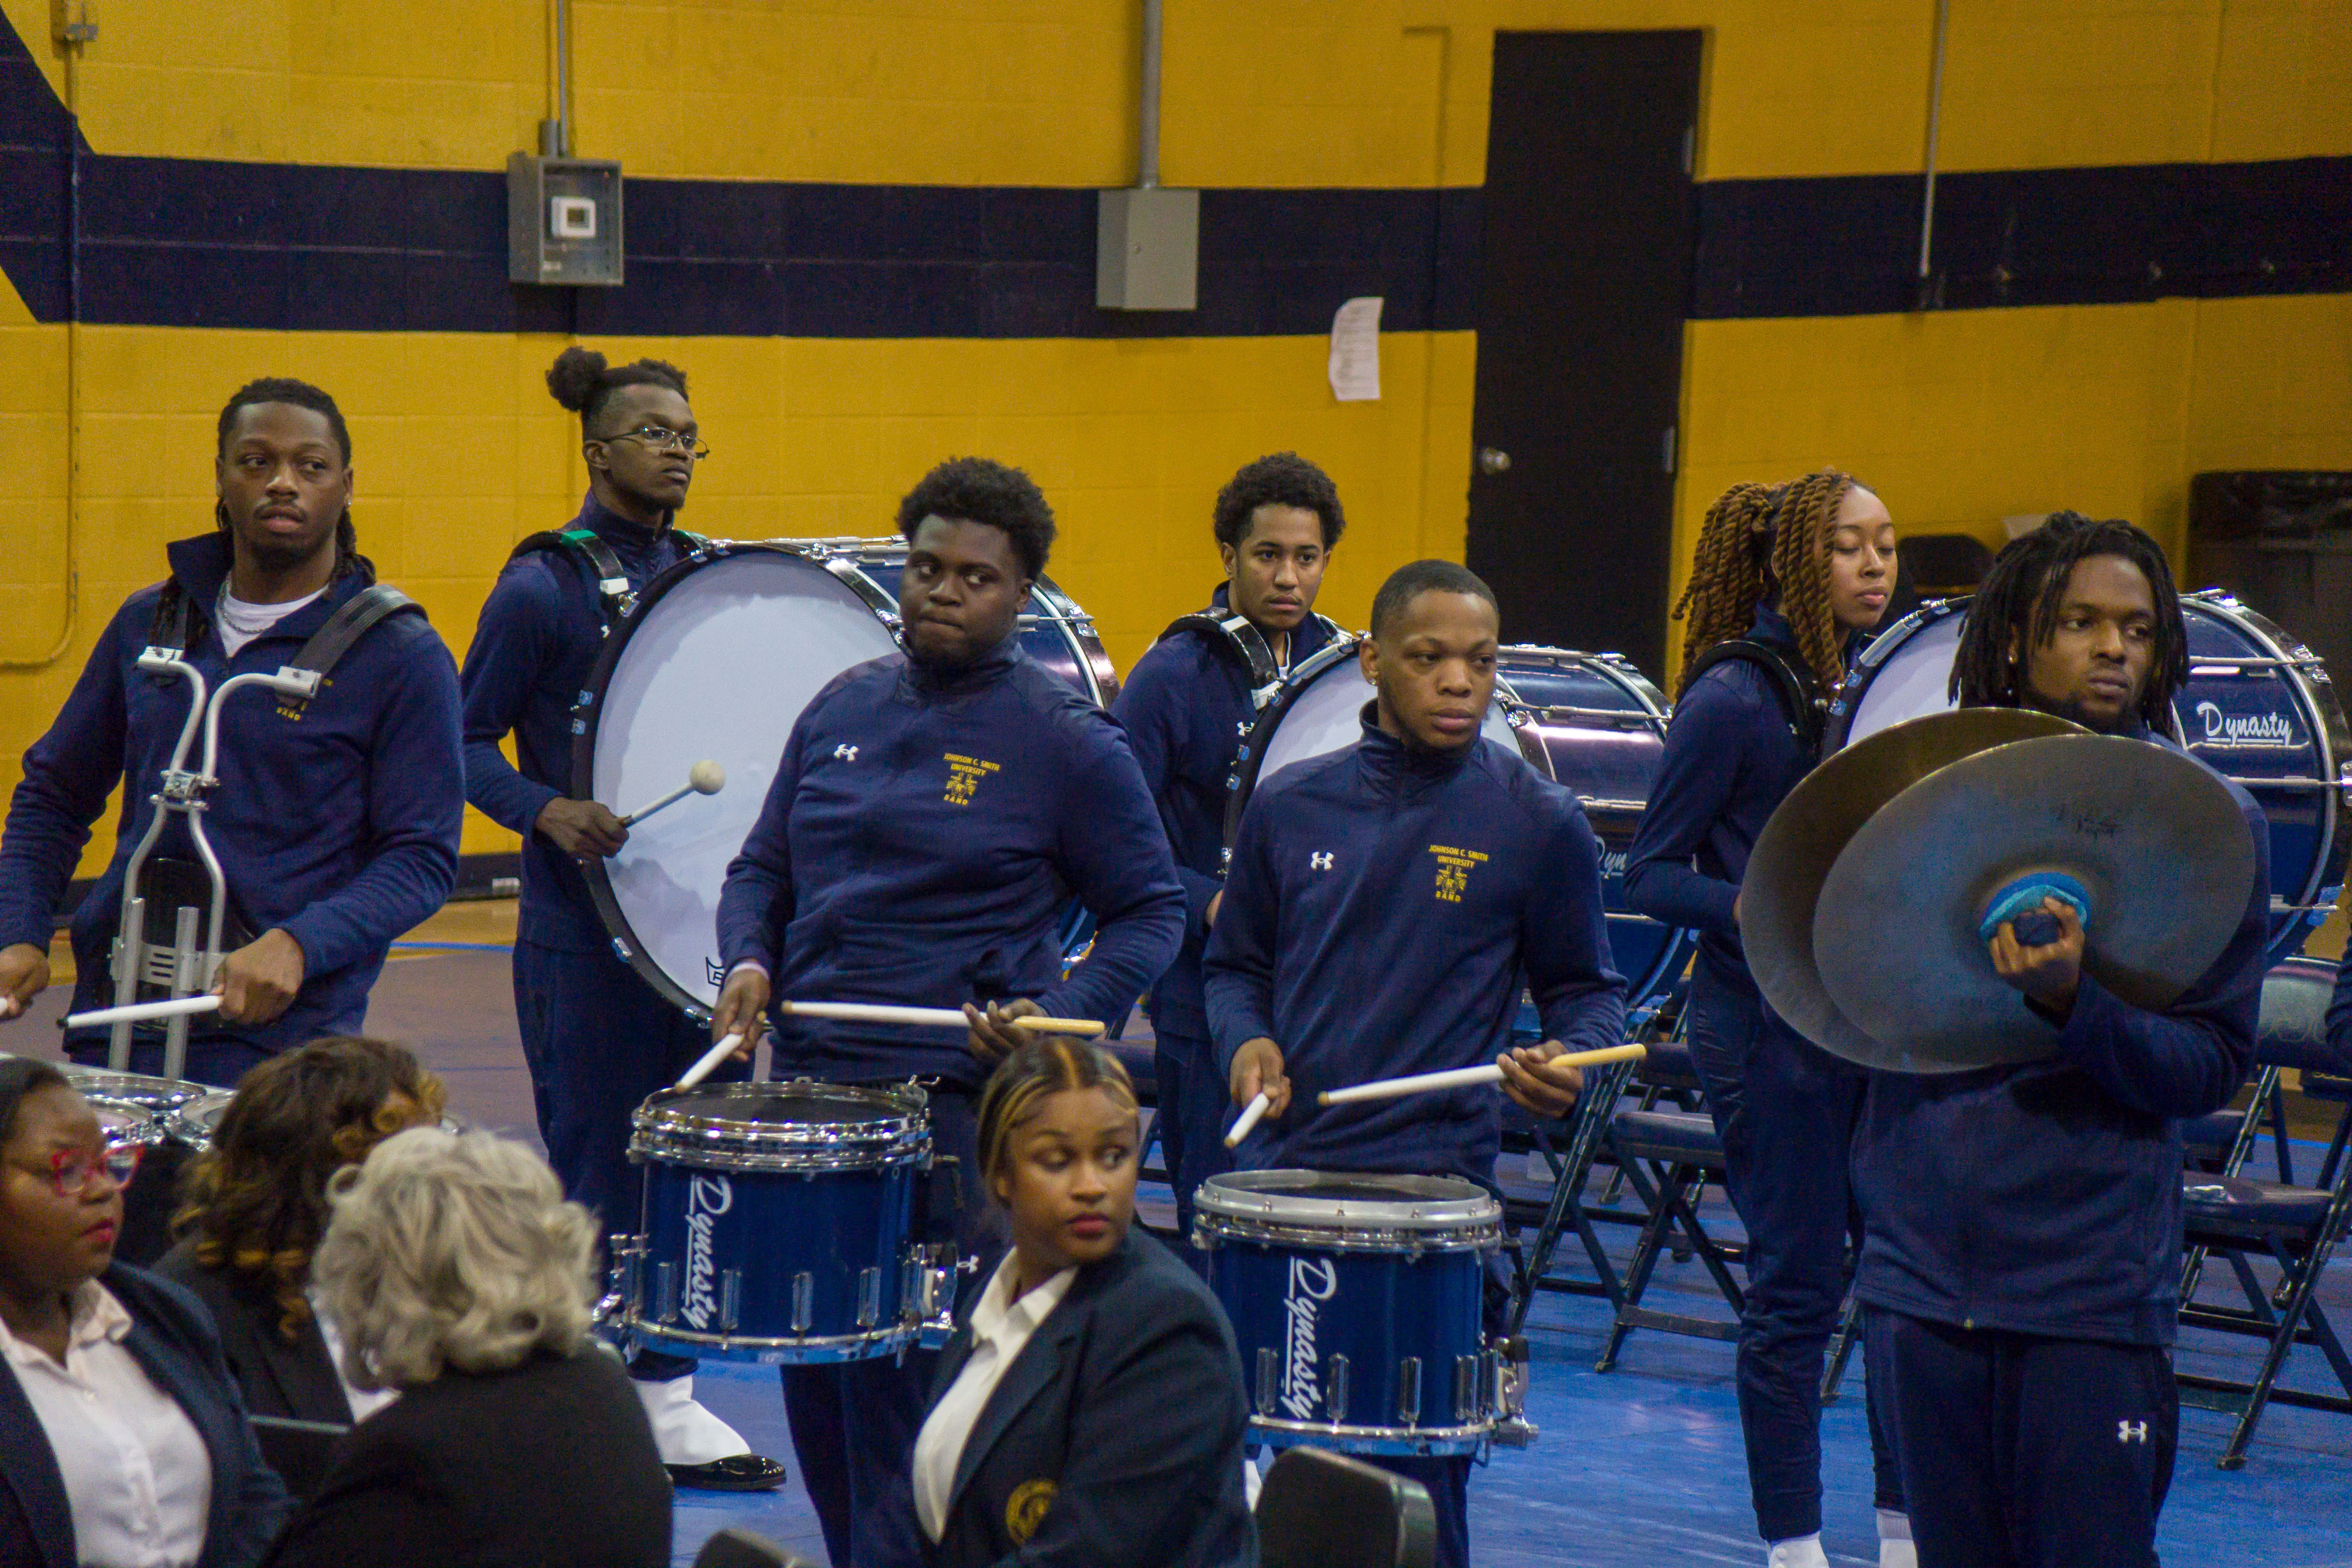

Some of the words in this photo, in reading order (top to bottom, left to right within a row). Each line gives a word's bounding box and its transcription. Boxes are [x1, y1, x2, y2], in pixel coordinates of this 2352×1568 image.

[2196, 701, 2293, 747] Dynasty
[943, 753, 972, 764] JOHNSON
[980, 760, 1001, 772] SMITH
[950, 763, 987, 776] UNIVERSITY
[943, 794, 968, 805] BAND
[1429, 845, 1459, 855] JOHNSON
[1468, 850, 1488, 862] SMITH
[1437, 855, 1475, 869] UNIVERSITY
[1436, 890, 1461, 903] BAND
[680, 1174, 732, 1329] Dynasty
[1280, 1256, 1336, 1419] Dynasty
